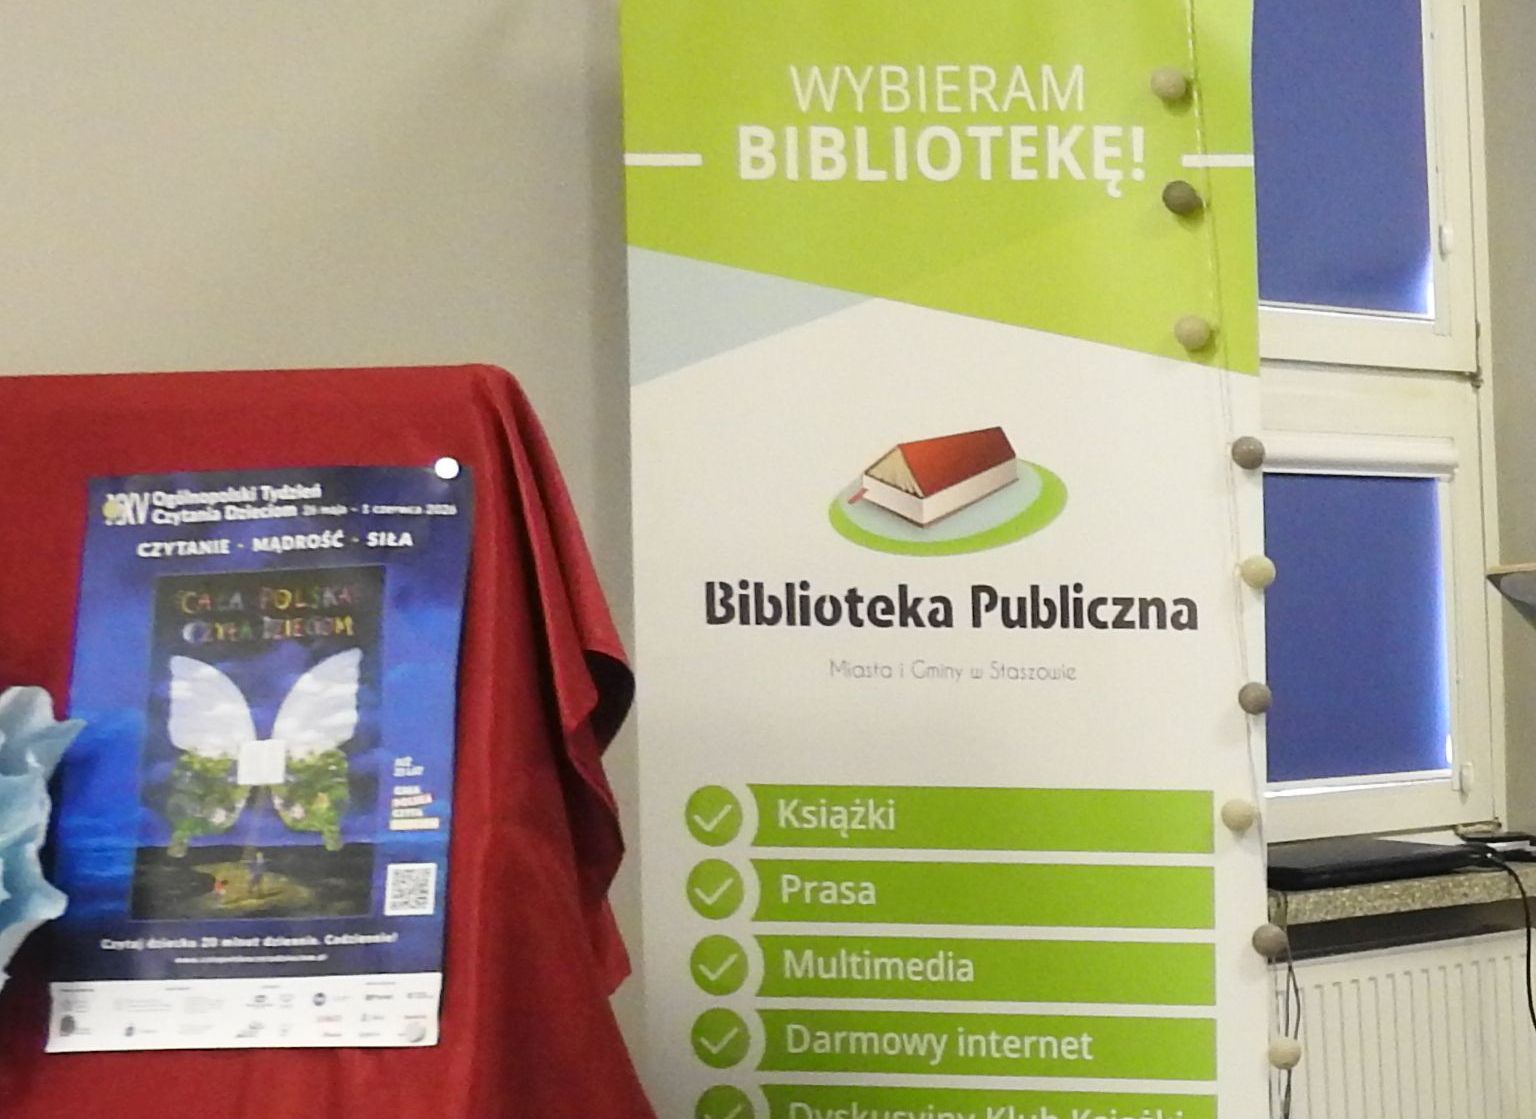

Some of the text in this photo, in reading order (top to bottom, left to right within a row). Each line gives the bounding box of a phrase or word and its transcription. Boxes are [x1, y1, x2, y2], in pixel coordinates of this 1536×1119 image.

[790, 64, 1085, 113] WYBIERAM
[736, 125, 1147, 199] BIBLIOTEKĘ!
[260, 483, 322, 503] Tydzień
[151, 502, 298, 526] Czytania Dzieciom
[136, 529, 414, 557] CZYTANIE MĄDROŚĆ SIŁA
[704, 579, 1199, 631] Biblioteka Publiczna
[828, 658, 1078, 683] Miasta i Gminy w Staszowie
[777, 797, 896, 837] Książki
[781, 873, 877, 906] Prasa
[783, 949, 975, 982] Multimedia
[786, 1023, 1094, 1065] Darmowy internet
